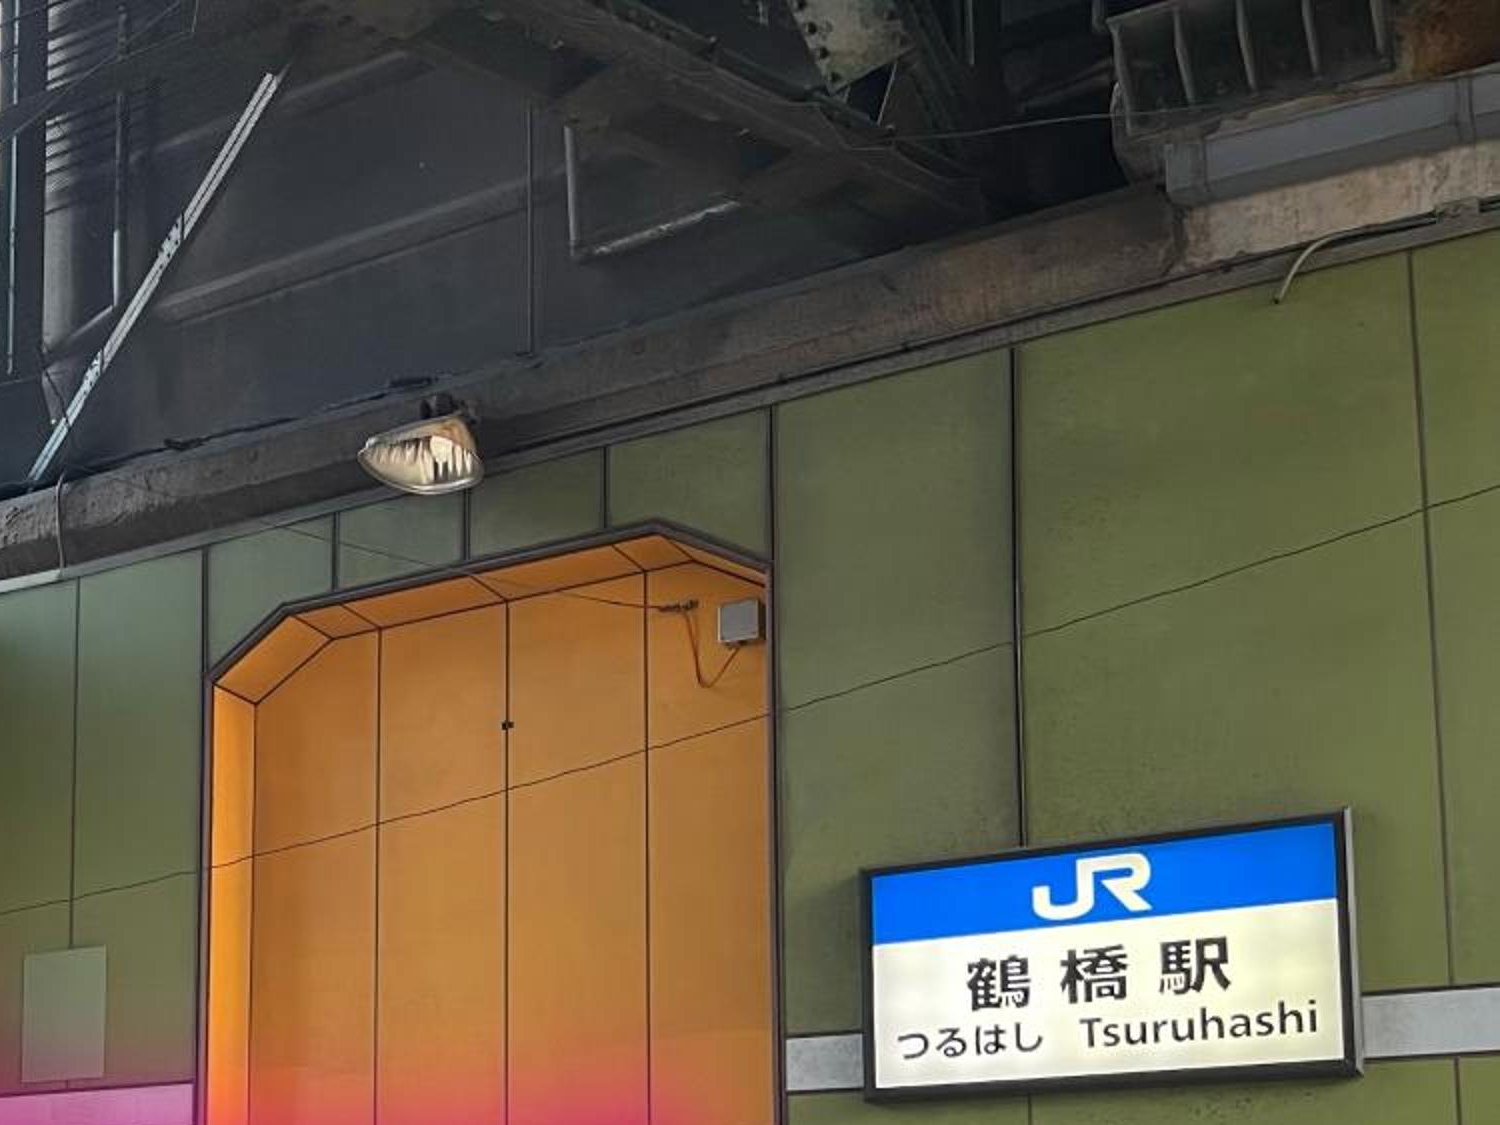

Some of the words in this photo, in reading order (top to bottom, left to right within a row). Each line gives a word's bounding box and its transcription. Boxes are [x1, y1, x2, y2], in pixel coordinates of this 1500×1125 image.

[1031, 851, 1153, 921] JR
[966, 936, 1232, 1012] 鶴橋駅
[897, 1021, 1044, 1061] つるはし
[1079, 999, 1319, 1050] Tsuruhashi
